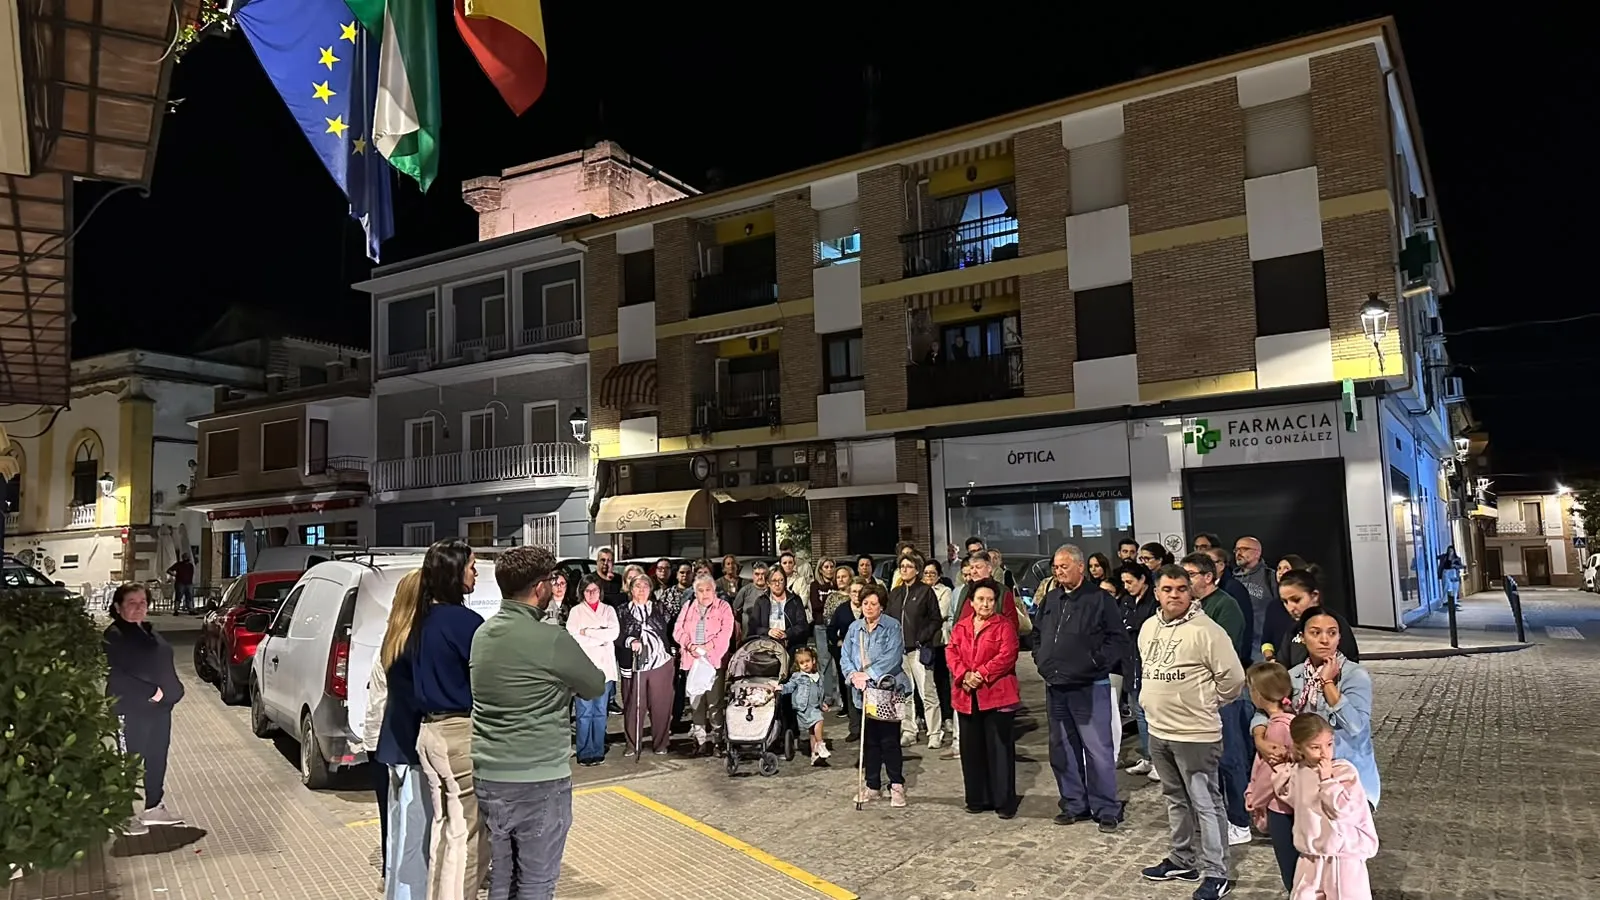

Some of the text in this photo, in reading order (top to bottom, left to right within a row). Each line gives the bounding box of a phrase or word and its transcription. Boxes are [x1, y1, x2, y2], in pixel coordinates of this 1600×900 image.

[1228, 413, 1332, 435] FARMACIA
[1229, 428, 1333, 448] RICO GONZÁLEZ
[1007, 449, 1056, 465] ÓPTICA
[1062, 491, 1095, 499] FARMACIA
[1152, 668, 1186, 683] Angels
